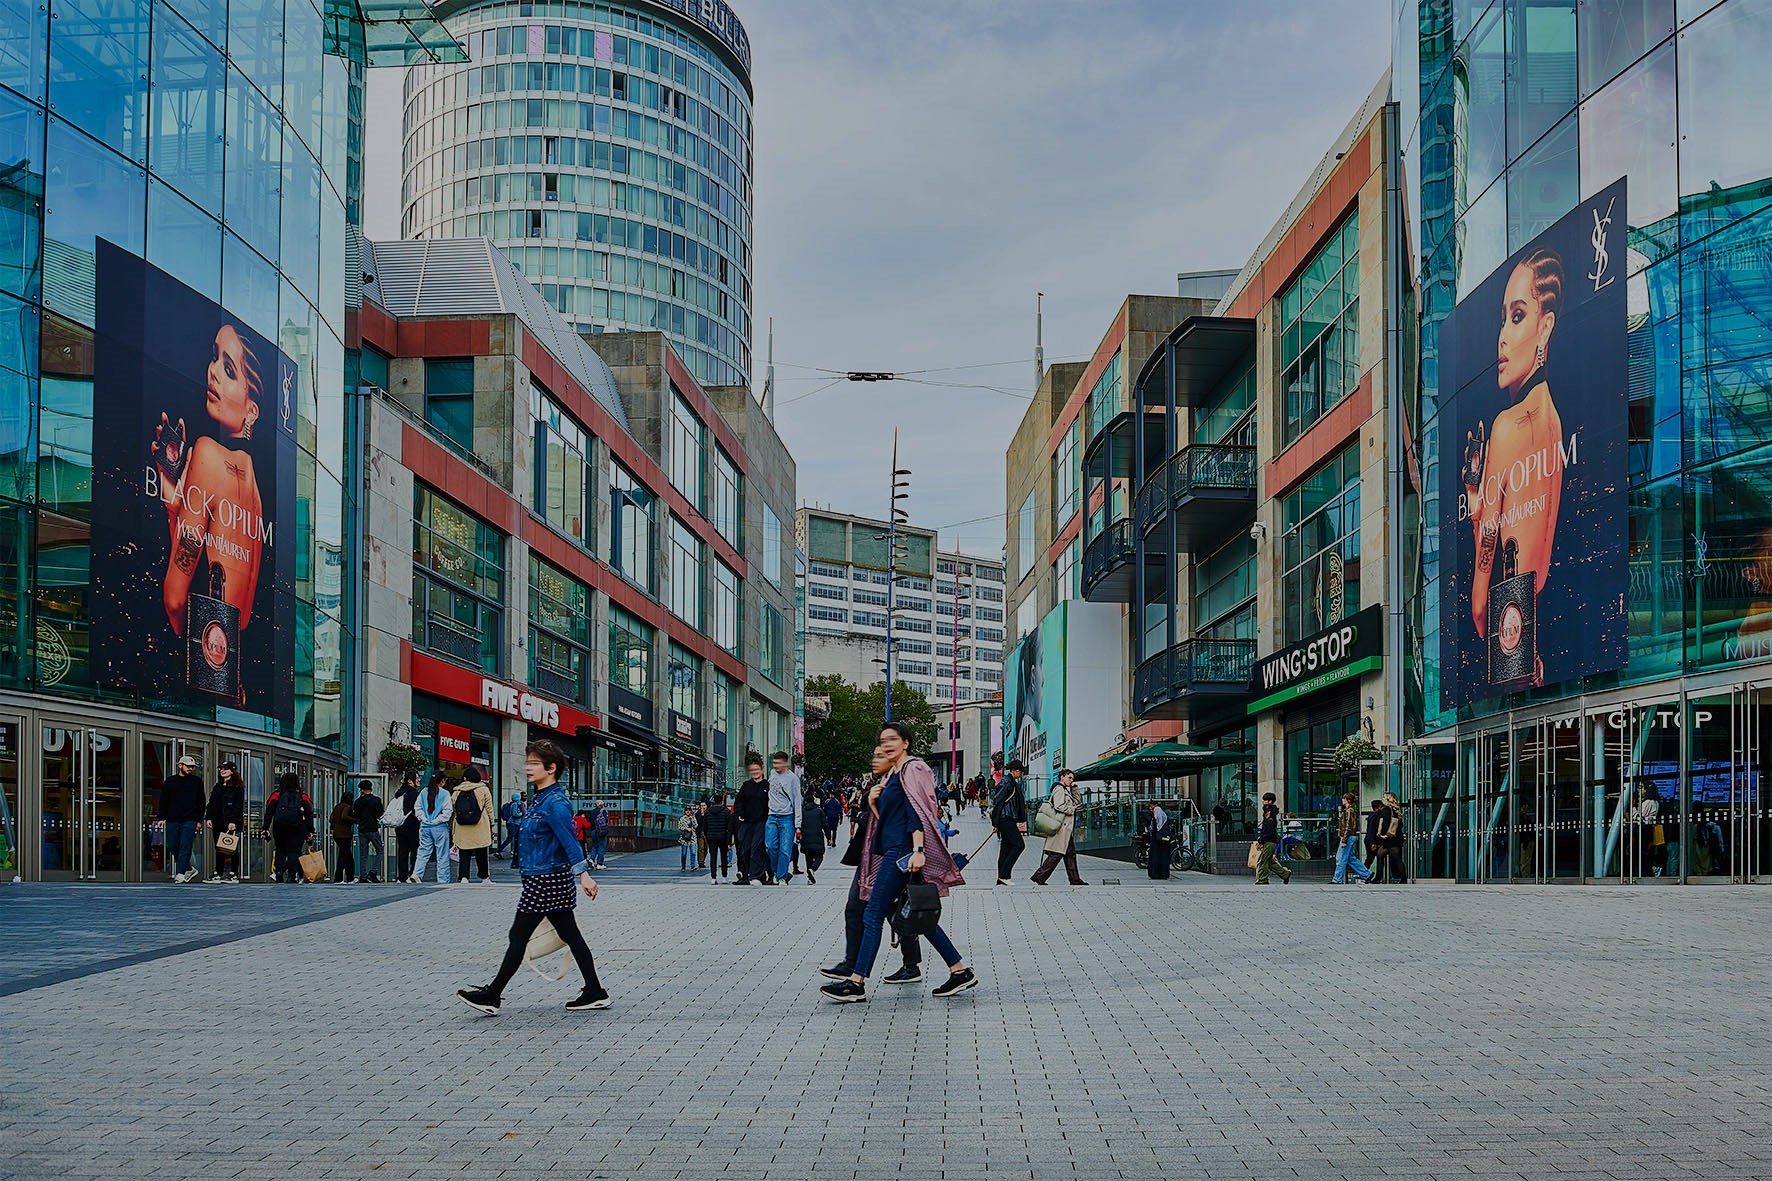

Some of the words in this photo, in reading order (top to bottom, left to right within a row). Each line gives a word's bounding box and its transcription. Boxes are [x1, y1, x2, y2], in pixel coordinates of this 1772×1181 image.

[1588, 196, 1617, 292] YSL
[282, 363, 295, 434] YSL
[145, 465, 215, 521] BLACK
[218, 498, 273, 547] OPIUM
[1458, 467, 1508, 522] BLACK
[1509, 432, 1578, 493] OPIUM
[434, 545, 455, 571] COFFEE
[481, 678, 519, 716] FIVE
[519, 691, 561, 729] GUYS
[1296, 683, 1311, 694] WINGS
[1314, 675, 1326, 688] FRIES
[1329, 667, 1350, 681] FLAVOUR
[440, 735, 454, 749] FIVE
[454, 738, 470, 752] GUYS
